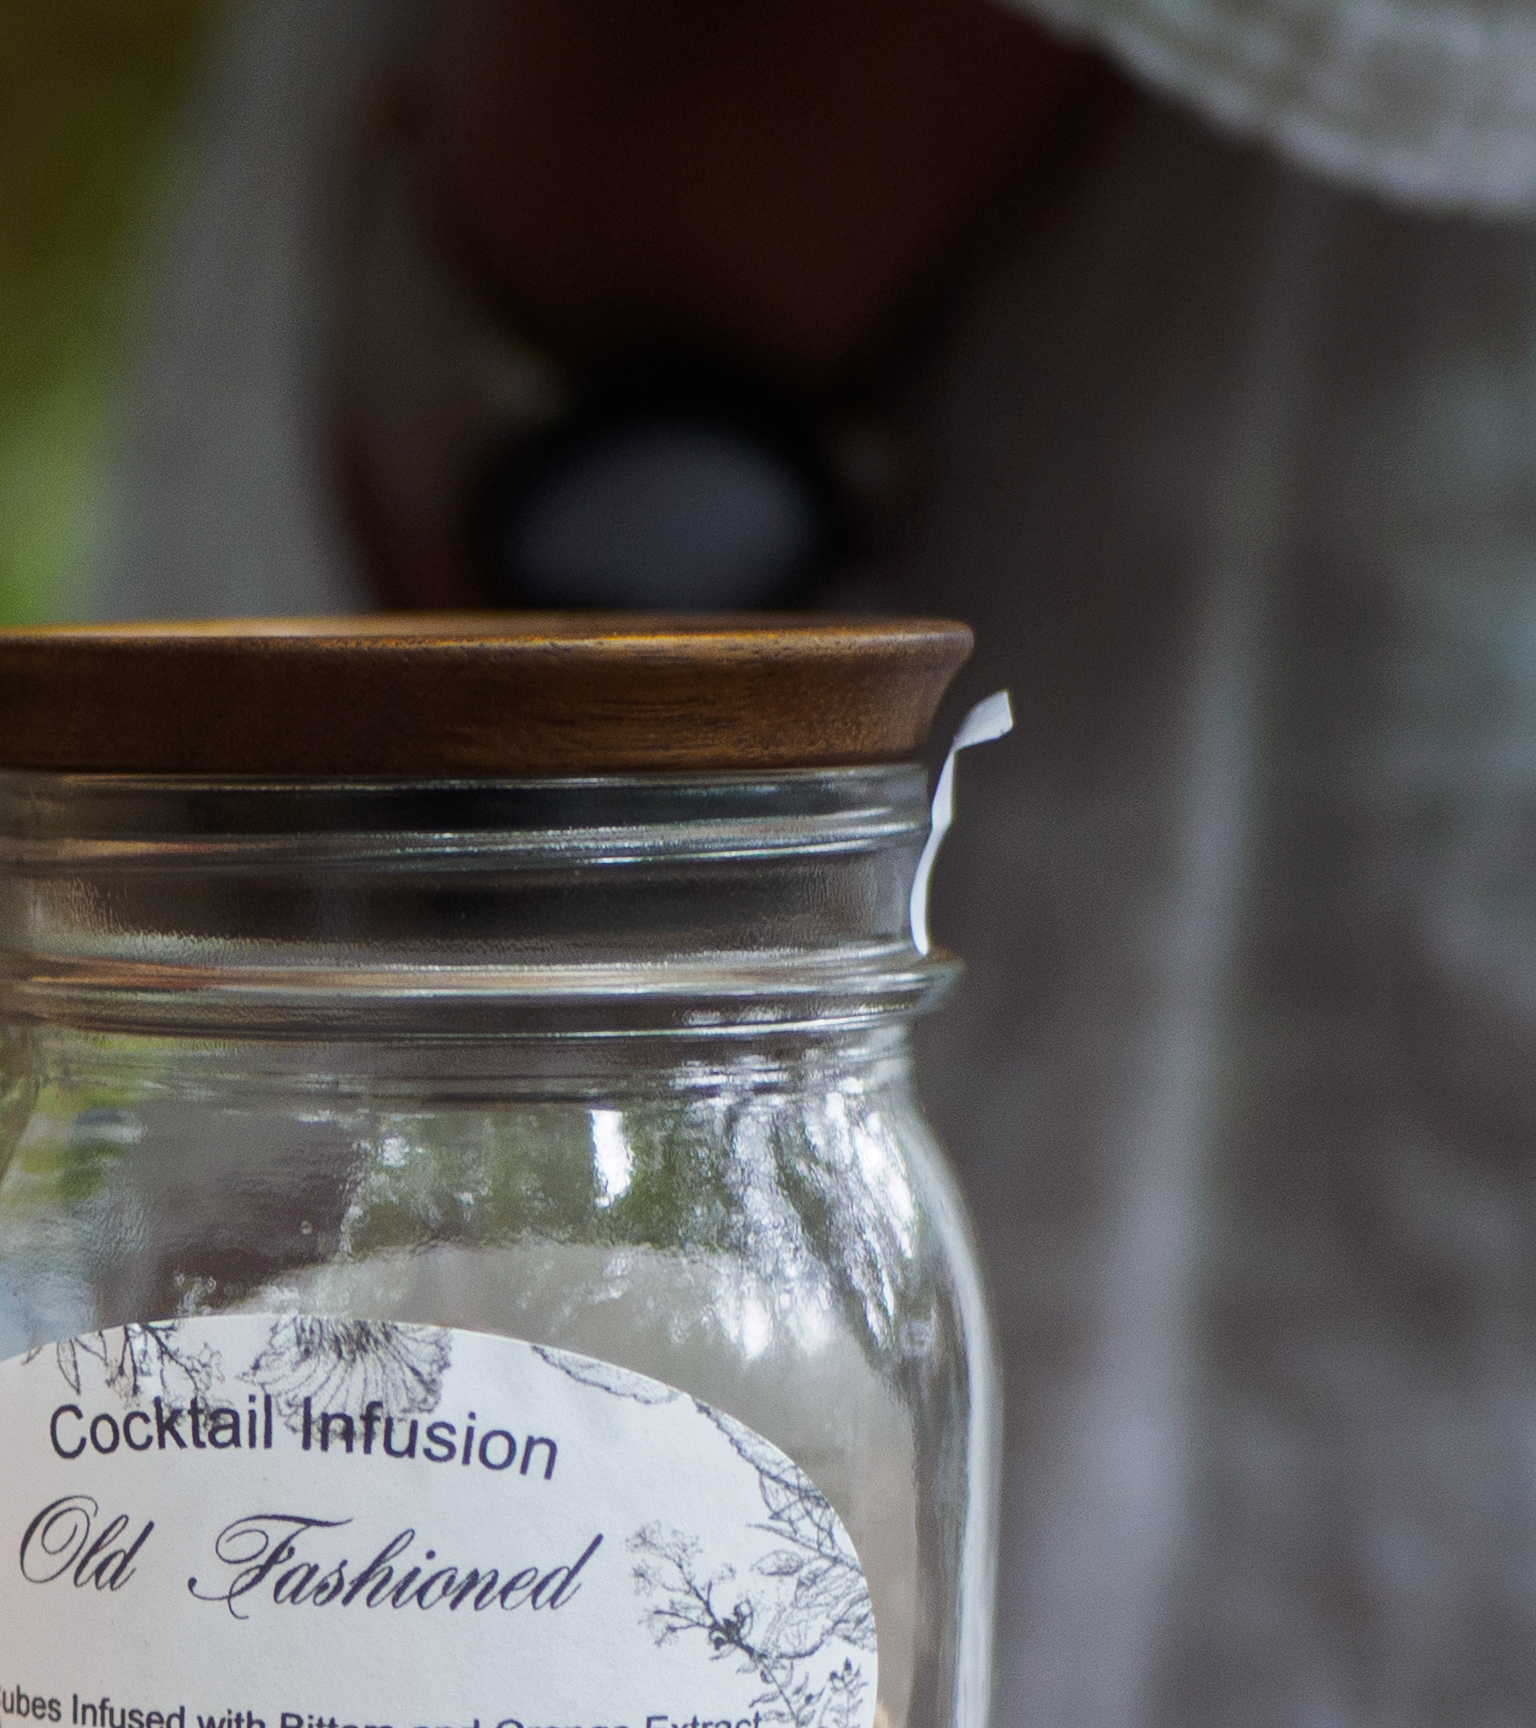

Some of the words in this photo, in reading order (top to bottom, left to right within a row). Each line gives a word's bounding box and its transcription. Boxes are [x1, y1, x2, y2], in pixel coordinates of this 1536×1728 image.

[49, 1394, 274, 1460] Cocktail
[301, 1395, 560, 1480] Infusion
[19, 1494, 156, 1593] Old
[187, 1513, 605, 1621] Fashioned
